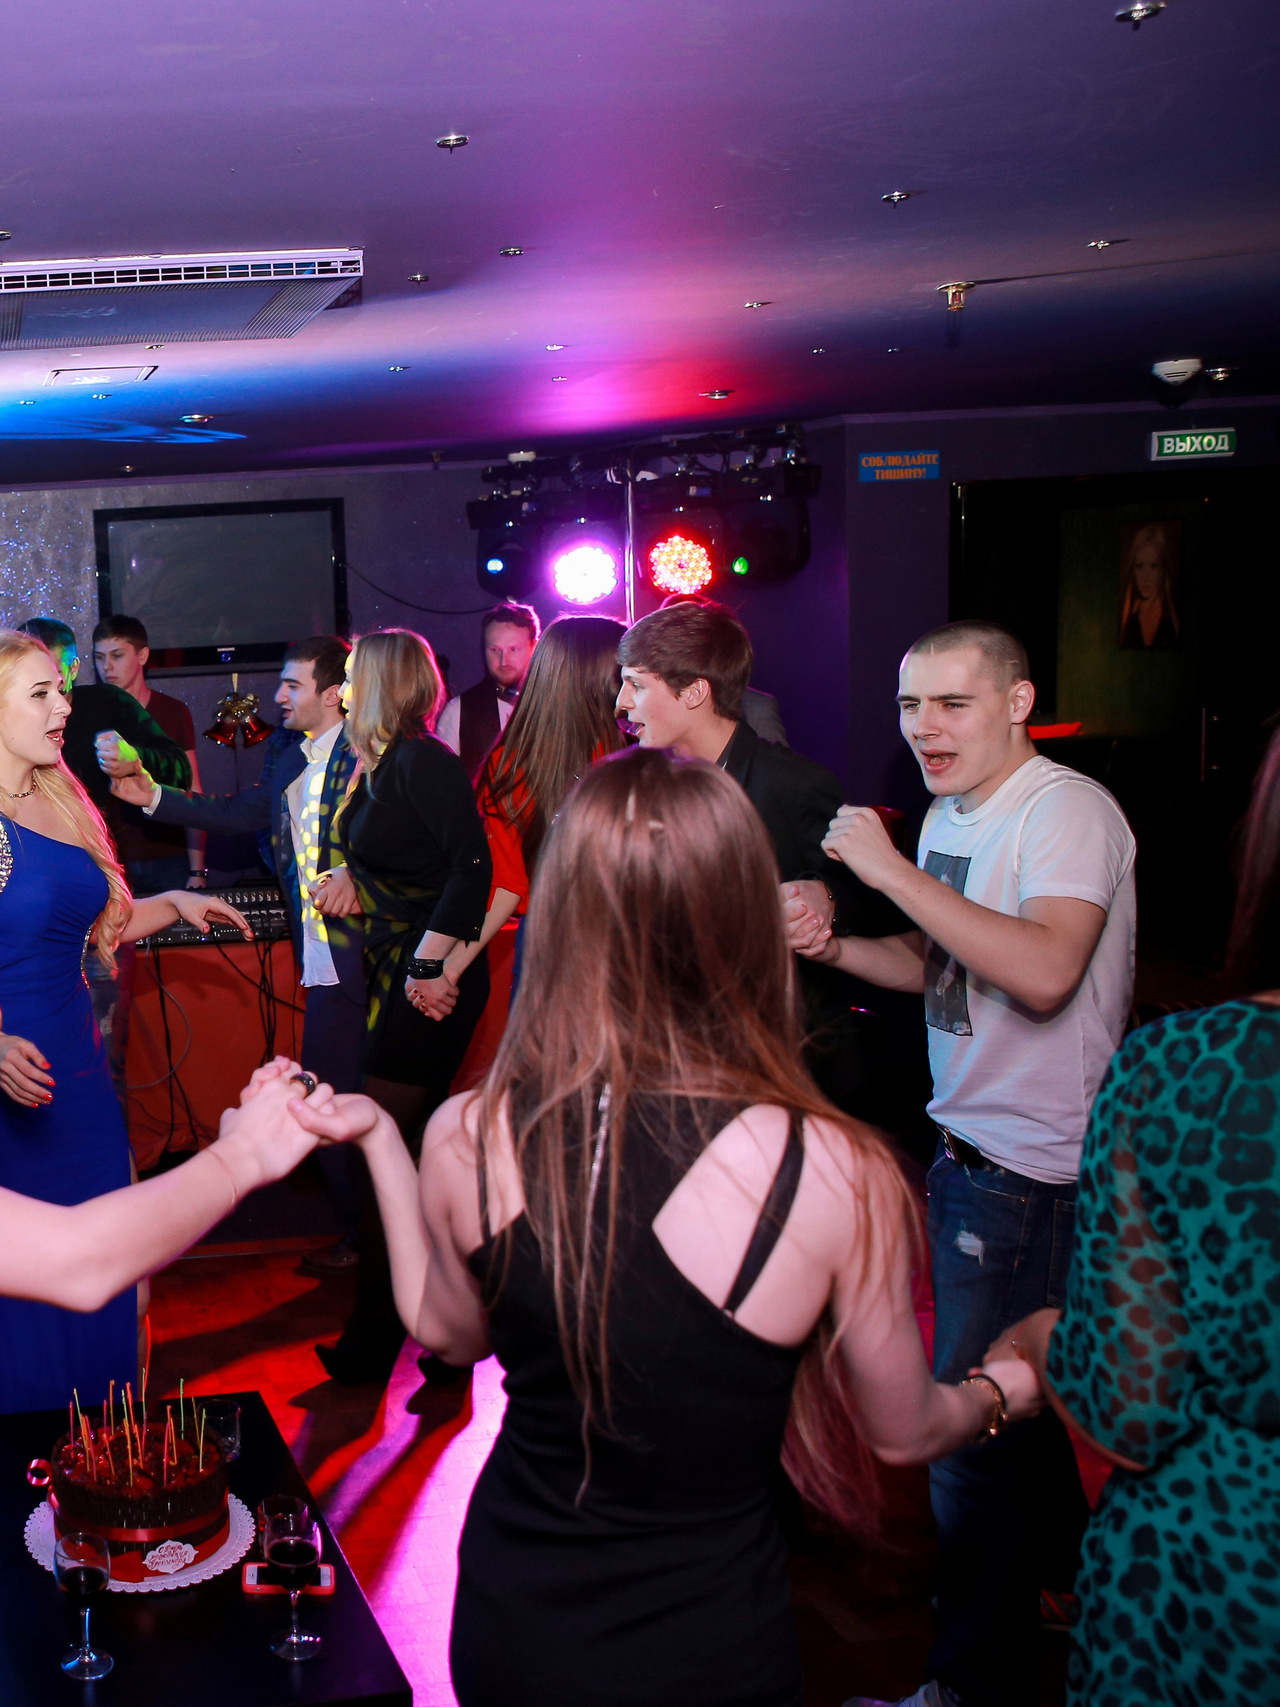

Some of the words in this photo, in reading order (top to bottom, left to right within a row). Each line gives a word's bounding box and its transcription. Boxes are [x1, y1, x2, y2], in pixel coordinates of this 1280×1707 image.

[1163, 434, 1229, 453] ВЫХОД
[861, 453, 939, 467] СОБЛЮДАЙТЕ
[874, 468, 926, 480] ТИШИНУ!
